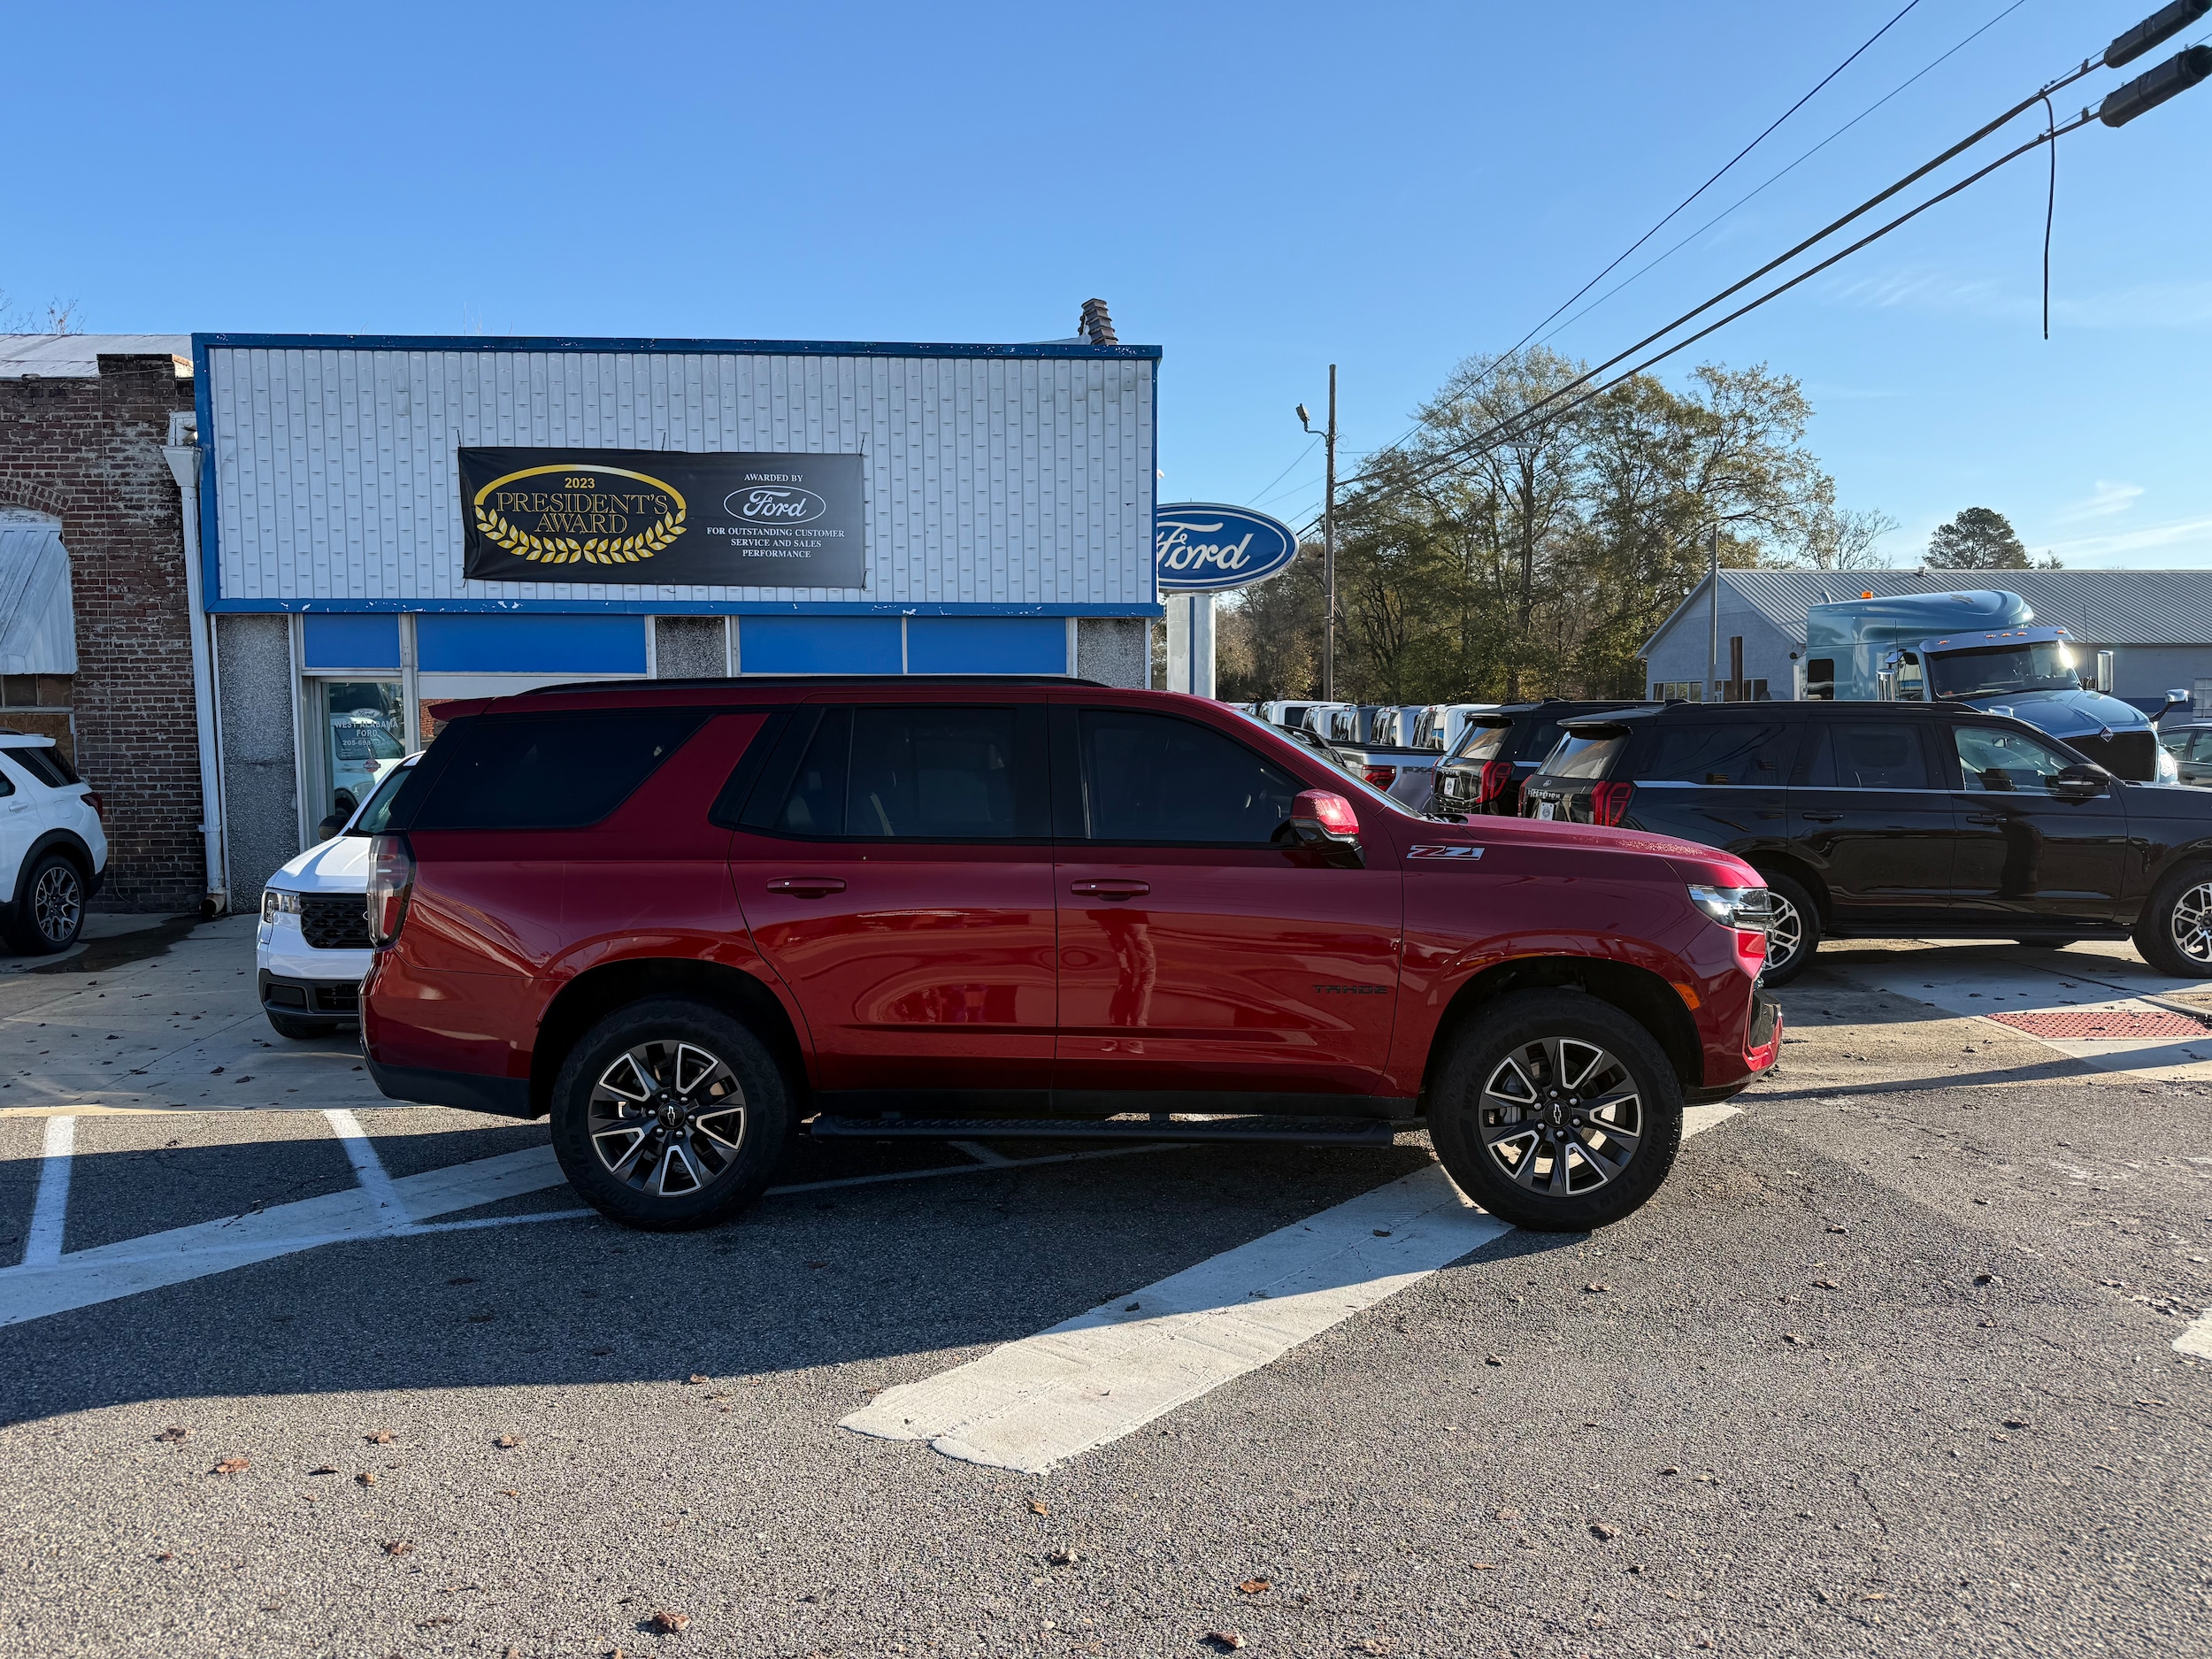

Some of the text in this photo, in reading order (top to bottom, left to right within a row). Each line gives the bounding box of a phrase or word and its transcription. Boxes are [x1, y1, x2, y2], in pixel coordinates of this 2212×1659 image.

[564, 477, 595, 489] 2023
[744, 473, 788, 482] AWARDED
[495, 492, 669, 516] PRESIDENT'S
[743, 489, 807, 518] Ford
[534, 512, 628, 534] AWARD
[706, 526, 726, 535] FOR
[728, 527, 793, 536] OUTSTANDING
[731, 538, 771, 547] SERVICE
[742, 549, 811, 557] PERFORMANCE
[357, 709, 375, 718] Ford
[1406, 844, 1486, 862] Z71
[1311, 984, 1388, 995] TAHOE
